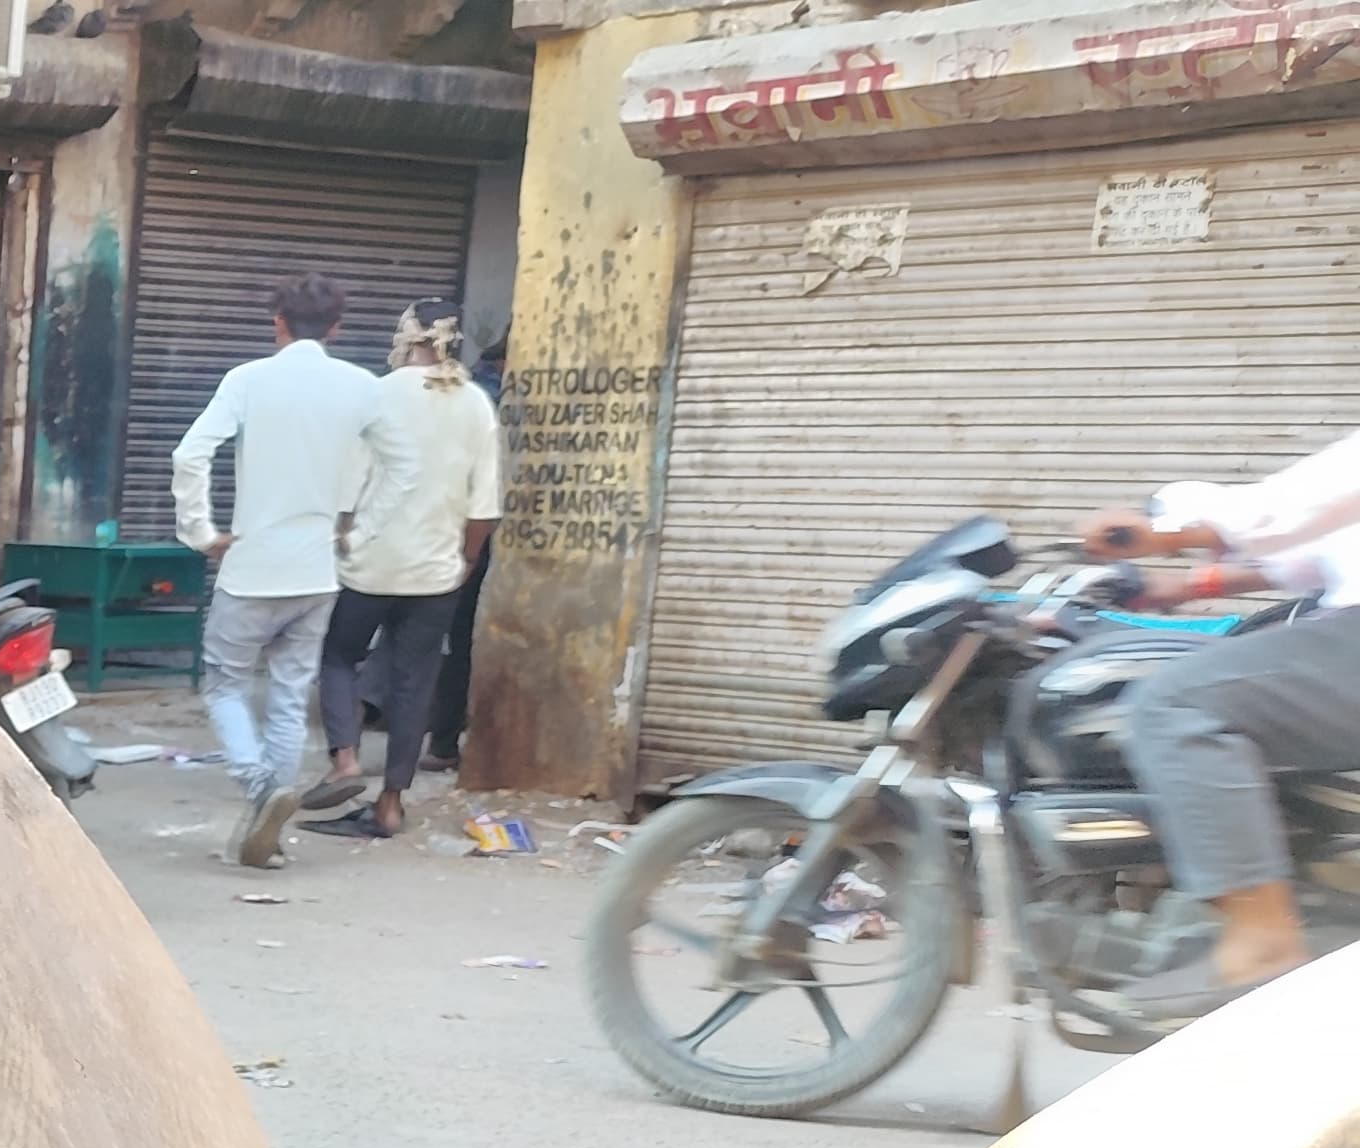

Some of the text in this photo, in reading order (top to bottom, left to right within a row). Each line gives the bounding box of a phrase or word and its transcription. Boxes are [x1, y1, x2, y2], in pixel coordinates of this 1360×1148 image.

[643, 48, 897, 146] भवानी
[500, 365, 661, 397] ASTROLOGER
[499, 402, 659, 427] GURU ZAFER SHAH
[507, 431, 640, 453] VASHIKARAN
